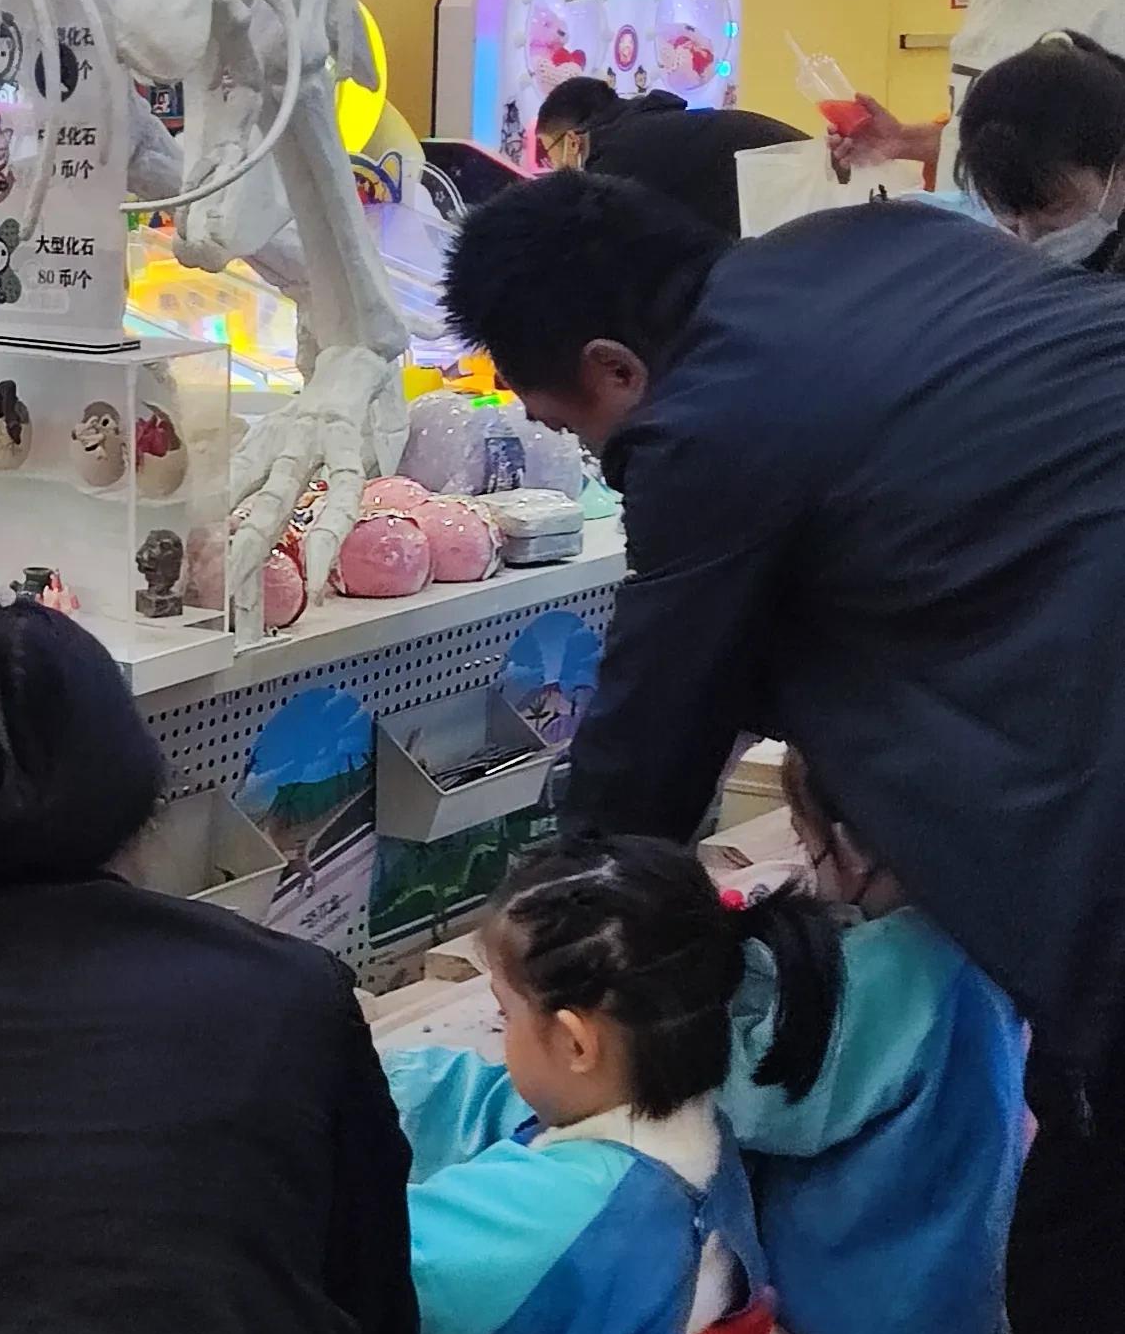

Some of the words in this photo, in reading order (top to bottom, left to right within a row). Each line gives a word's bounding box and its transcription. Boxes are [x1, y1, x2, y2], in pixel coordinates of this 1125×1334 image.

[35, 234, 95, 256] 大型化石
[37, 269, 55, 285] 80
[58, 268, 93, 289] 币/个
